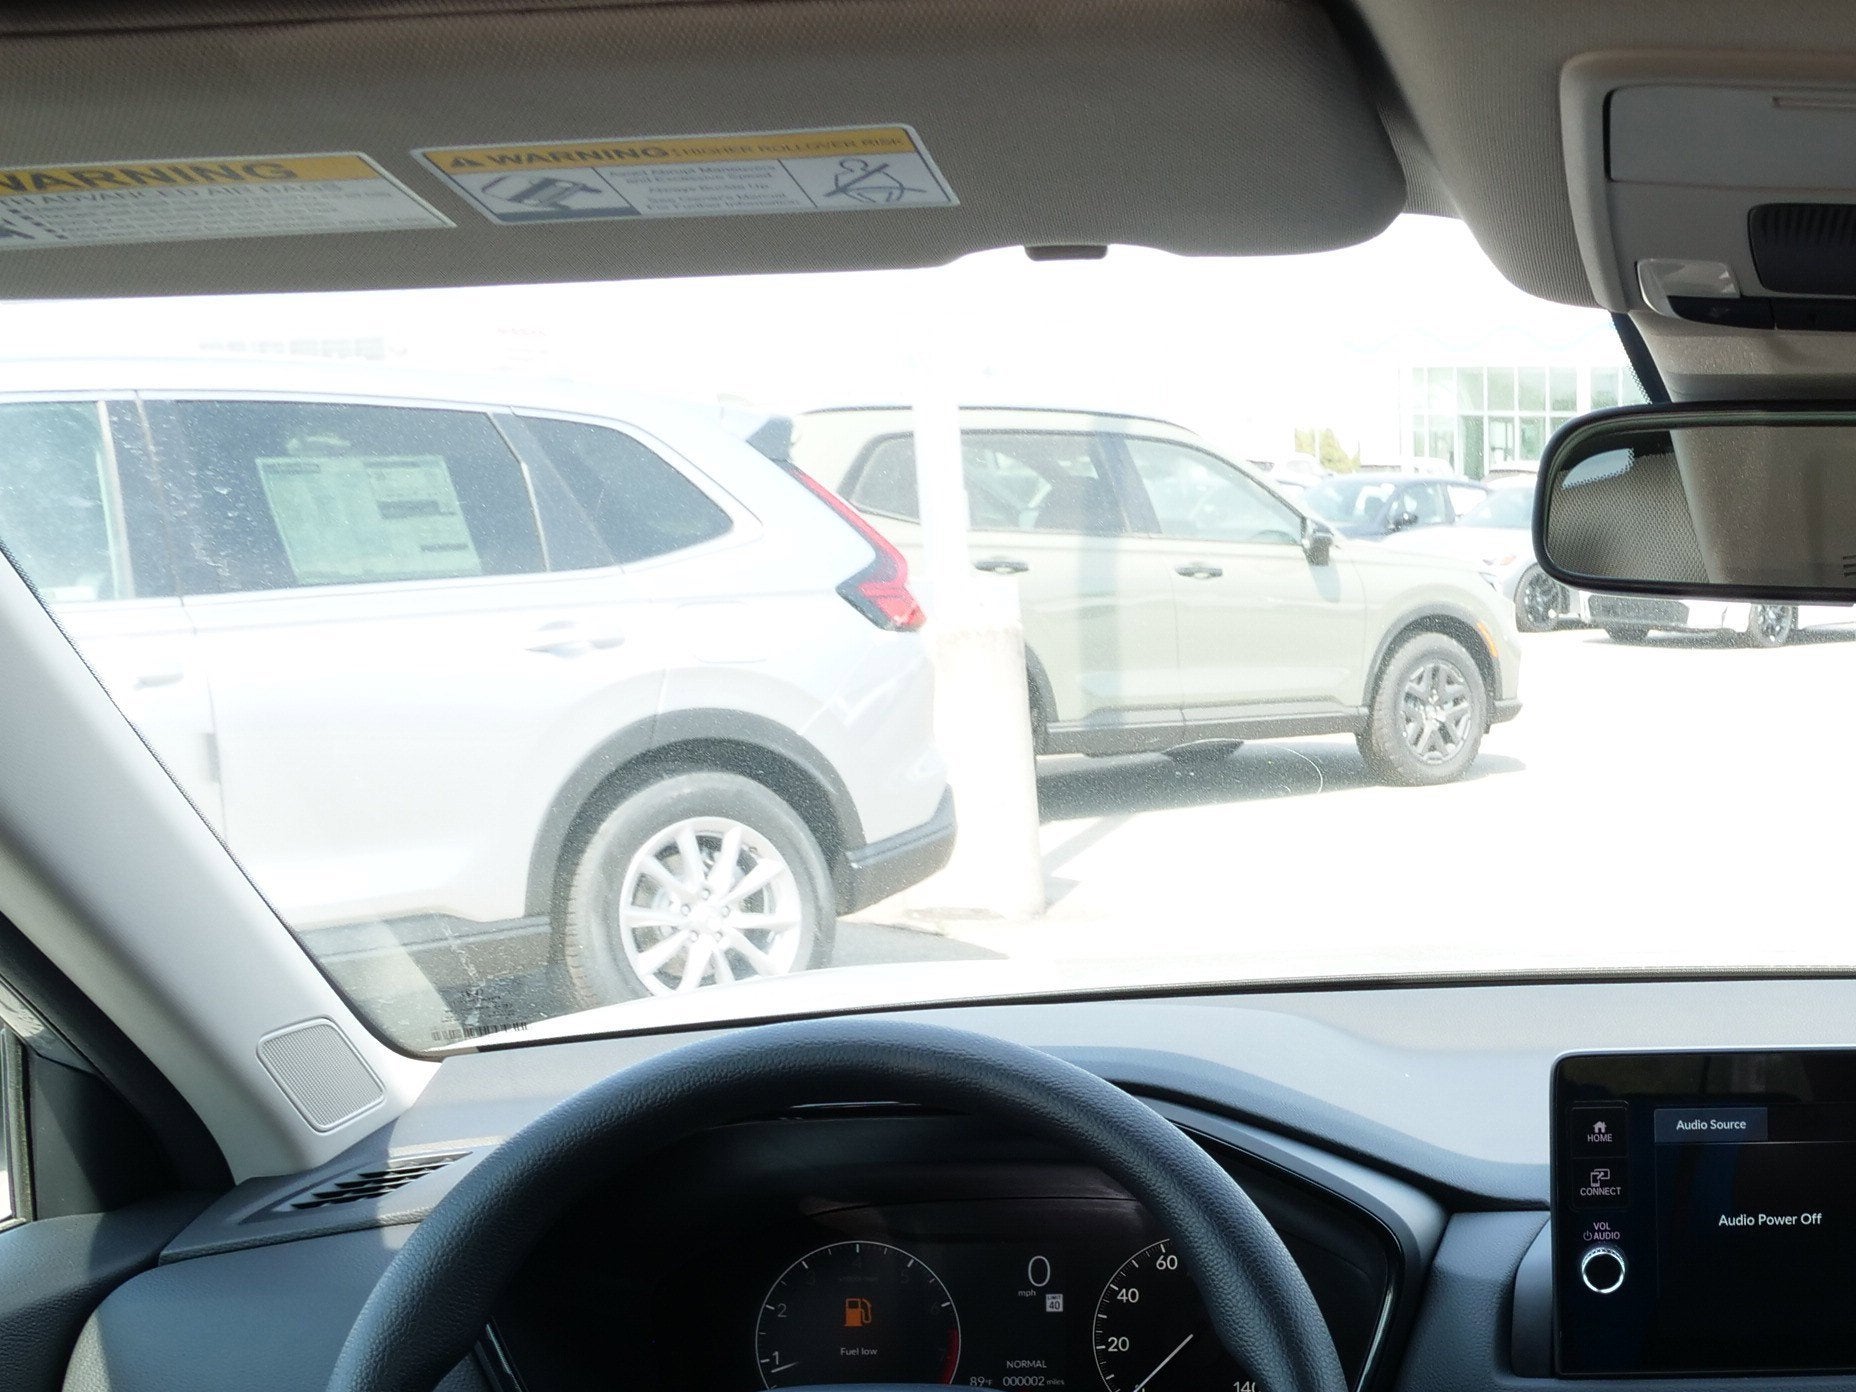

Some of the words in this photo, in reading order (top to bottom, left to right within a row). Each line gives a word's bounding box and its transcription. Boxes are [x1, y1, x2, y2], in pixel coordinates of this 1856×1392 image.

[1676, 1119, 1708, 1130] Audio
[1710, 1119, 1747, 1130] Source
[1587, 1134, 1613, 1142] HOME
[1580, 1187, 1621, 1196] CONNECT
[1718, 1214, 1755, 1226] Audio
[1758, 1214, 1797, 1226] Power
[1800, 1212, 1822, 1224] Off
[1593, 1222, 1611, 1230] VOL
[1593, 1231, 1620, 1240] AUDIO
[1156, 1255, 1178, 1270] 60
[1028, 1255, 1051, 1287] 0
[1018, 1290, 1036, 1298] mph
[1116, 1287, 1139, 1303] 40
[777, 1303, 787, 1317] 2
[1049, 1301, 1061, 1310] 40
[1107, 1336, 1130, 1352] 20
[840, 1347, 859, 1356] Fuel
[861, 1347, 878, 1356] low
[772, 1351, 779, 1365] 1
[1006, 1360, 1047, 1369] NORMAL
[1002, 1376, 1045, 1387] 000002
[1046, 1377, 1065, 1386] miles
